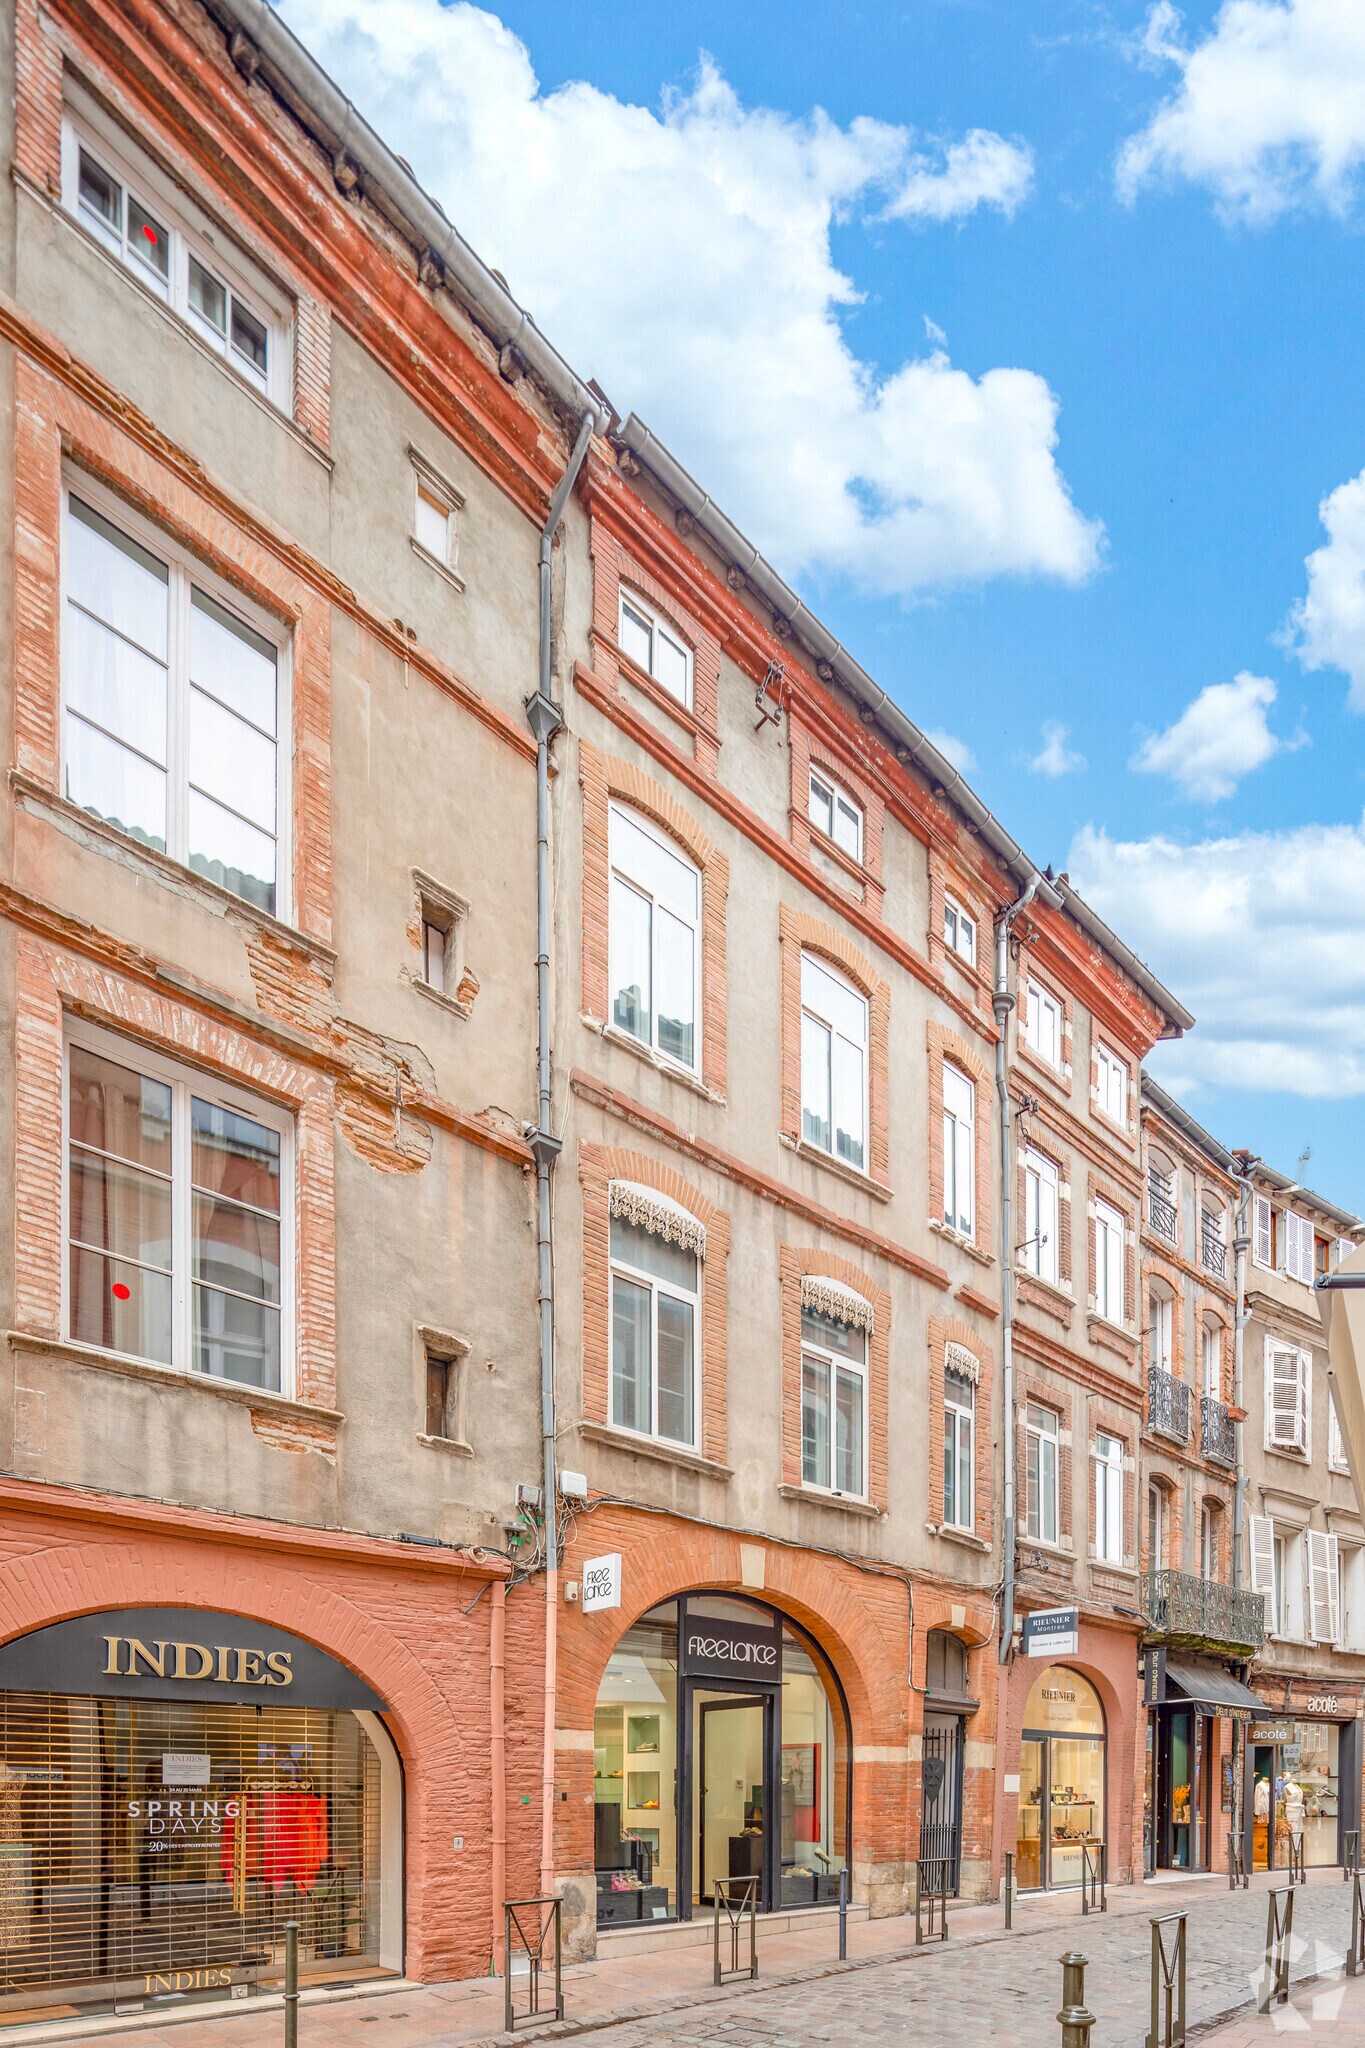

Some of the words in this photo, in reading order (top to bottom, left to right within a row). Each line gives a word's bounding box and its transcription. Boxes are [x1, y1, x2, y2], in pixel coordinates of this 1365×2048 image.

[1032, 1616, 1070, 1627] RIEUNIER
[102, 1636, 293, 1686] INDIES
[1041, 1689, 1076, 1703] RIEUNIER
[1307, 1695, 1338, 1714] acoté
[1252, 1728, 1287, 1740] acoté
[171, 1755, 203, 1763] INDIES
[128, 1801, 240, 1817] SPRING
[149, 1817, 221, 1834] DAYS
[149, 1841, 168, 1852] 20%
[144, 1968, 231, 1993] INDIES
